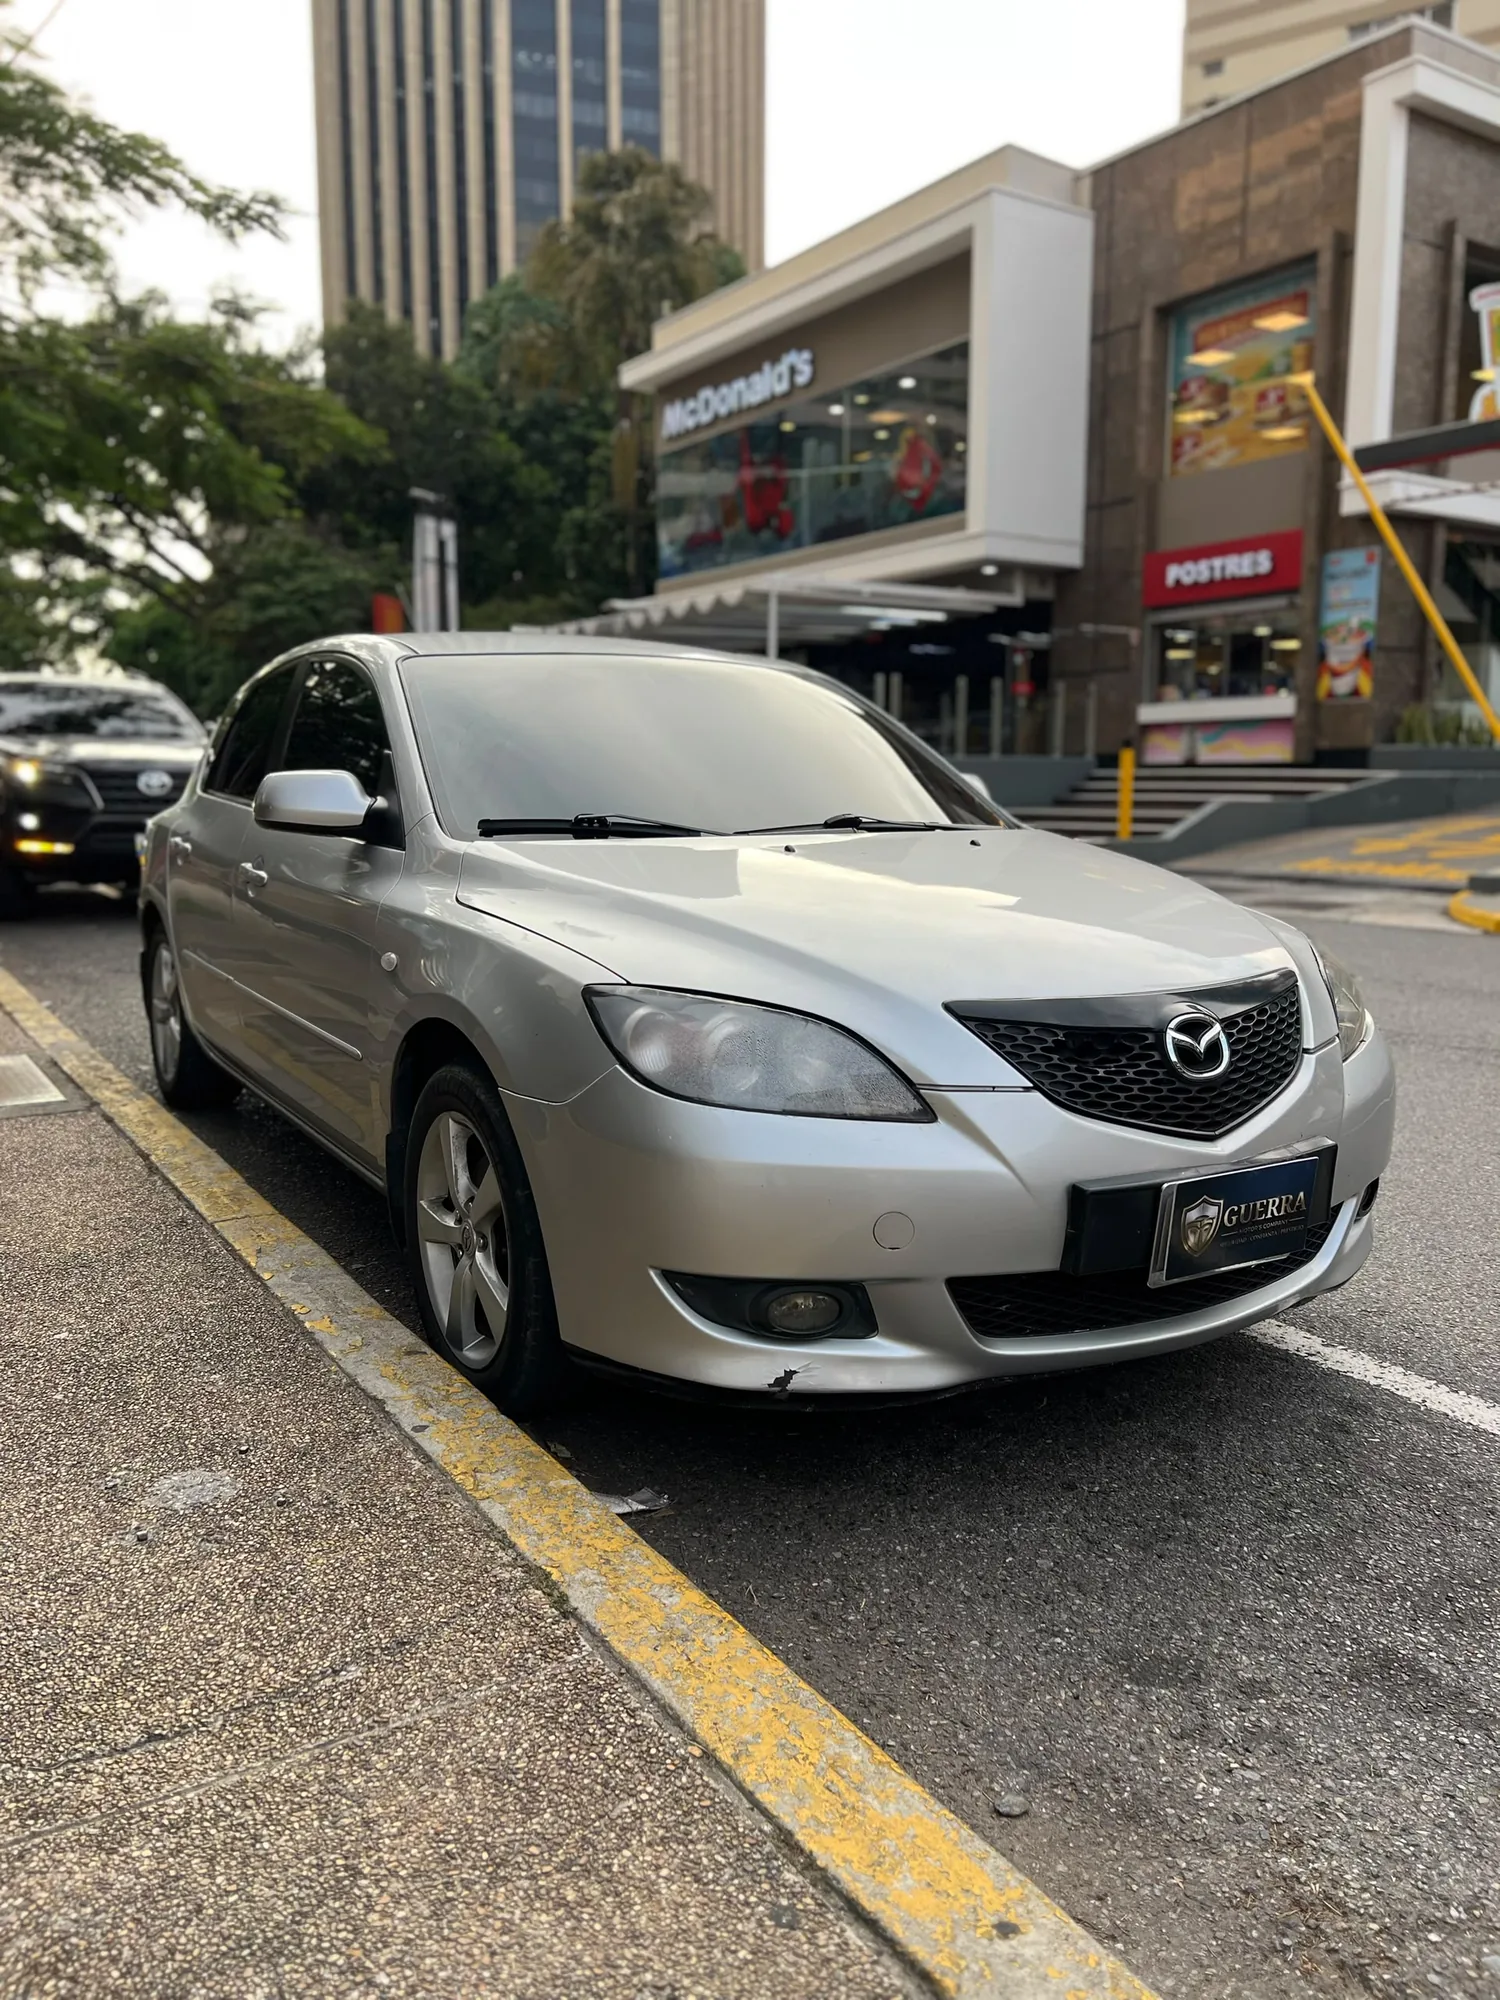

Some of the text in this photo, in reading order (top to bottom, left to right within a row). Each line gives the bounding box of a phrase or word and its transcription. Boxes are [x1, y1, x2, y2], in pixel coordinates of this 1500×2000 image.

[662, 349, 813, 437] McDonald's
[1165, 549, 1273, 588] POSTRES
[1224, 1191, 1306, 1227] GUERRA
